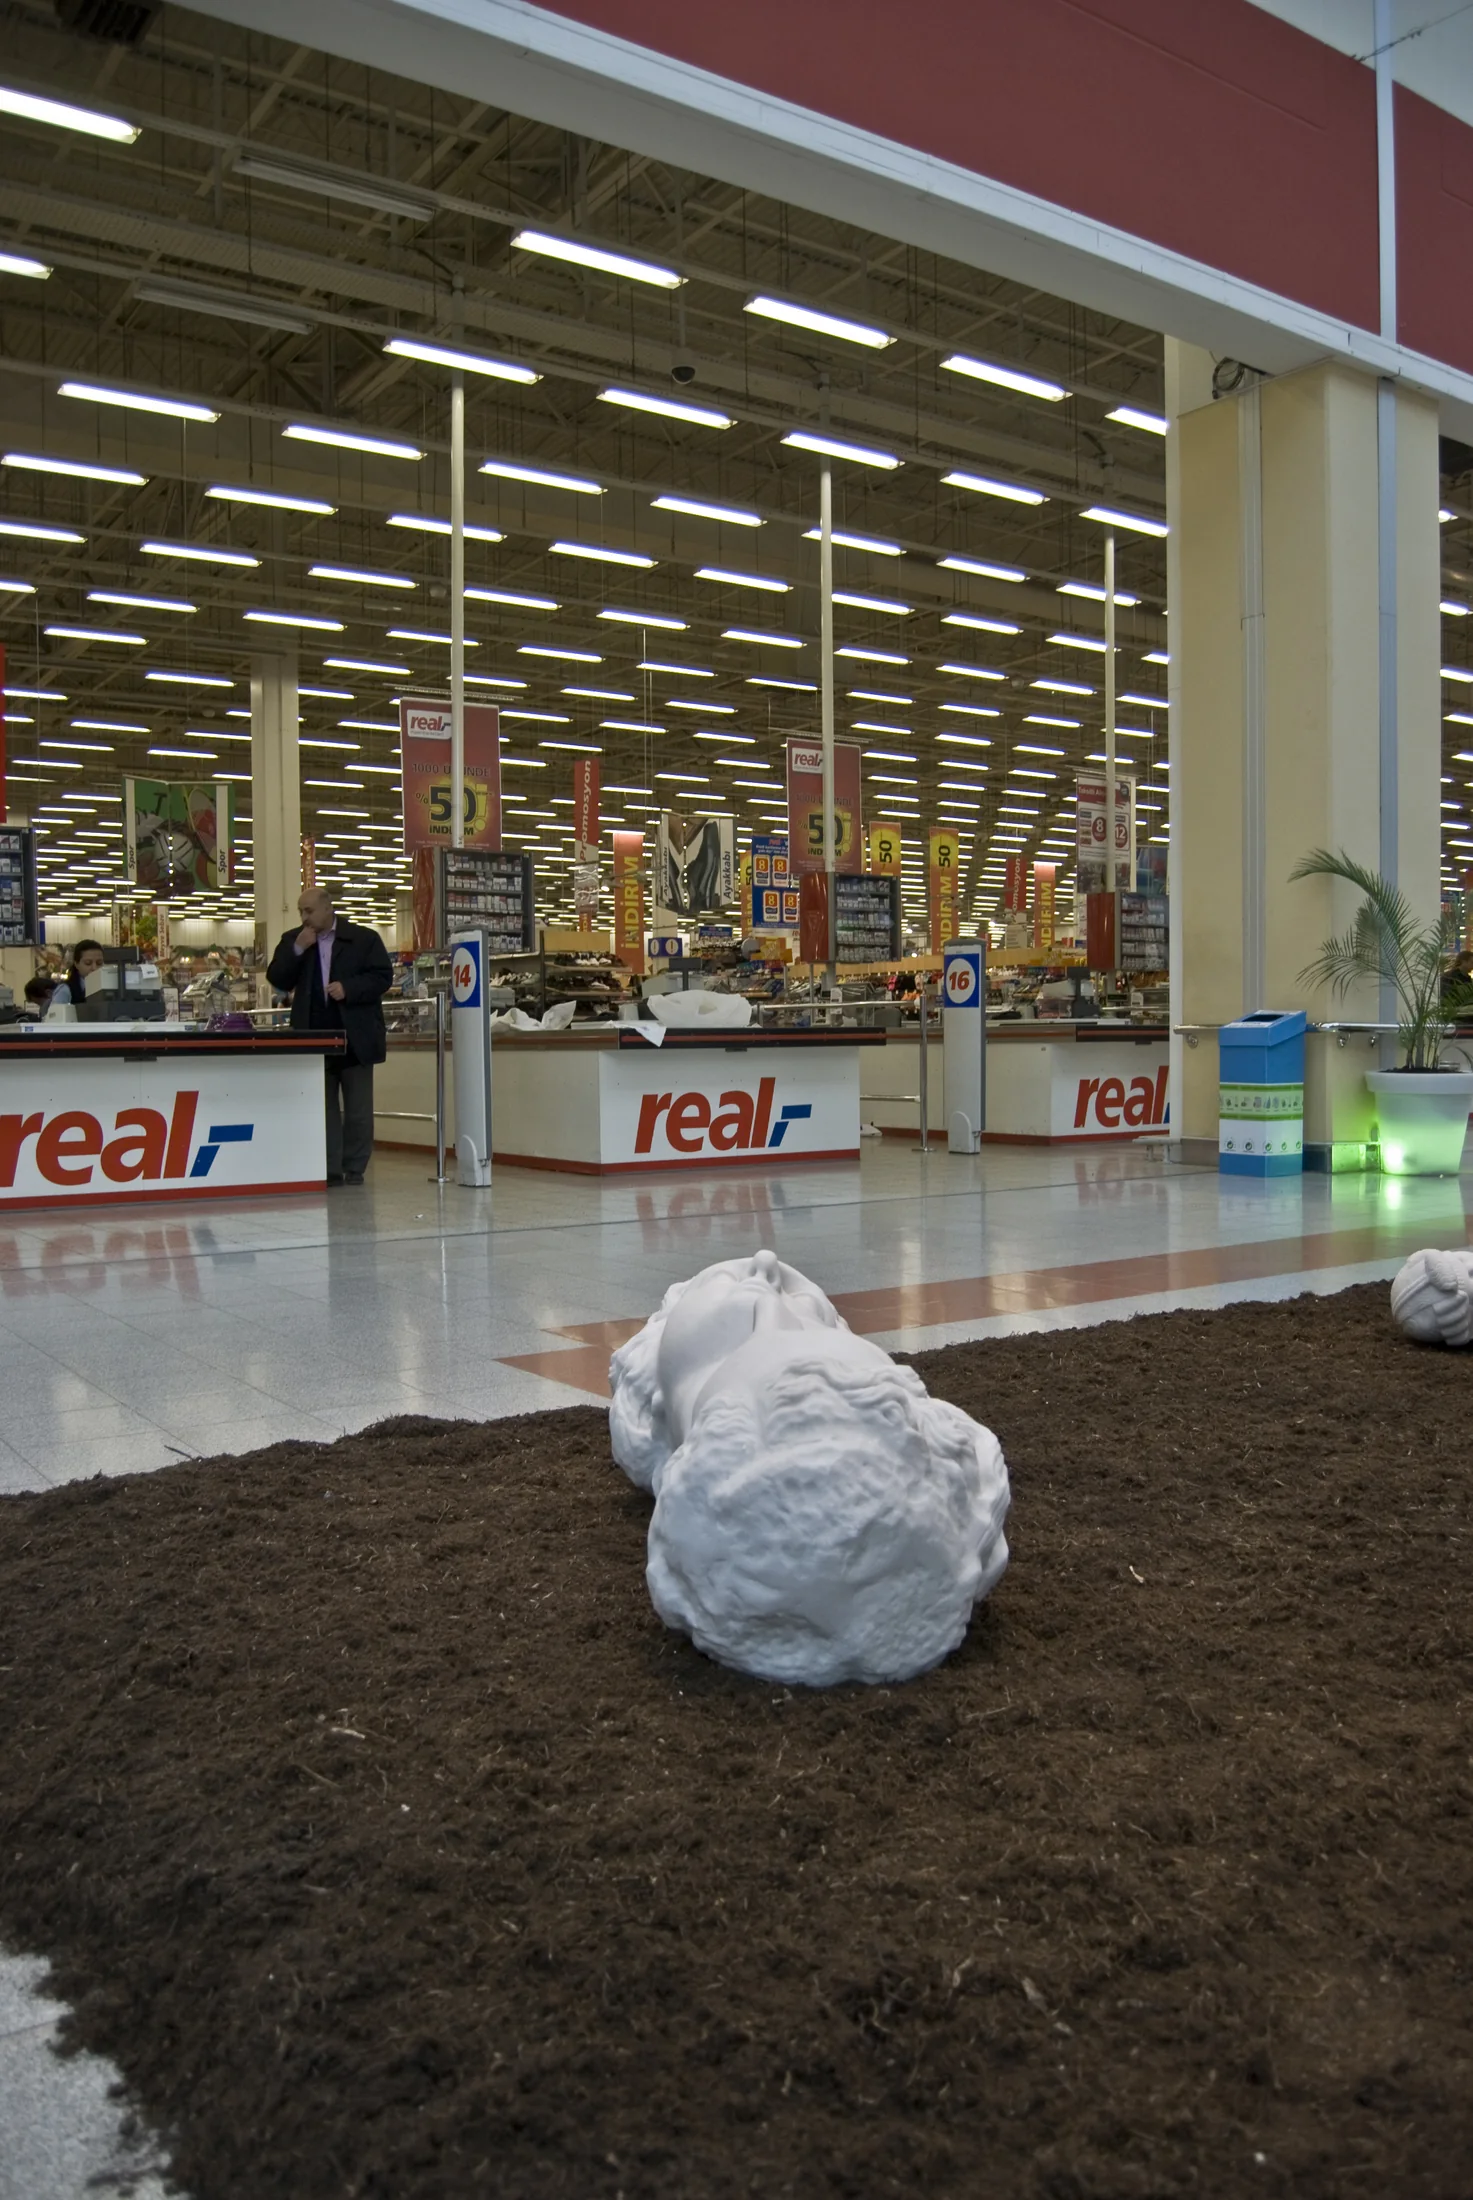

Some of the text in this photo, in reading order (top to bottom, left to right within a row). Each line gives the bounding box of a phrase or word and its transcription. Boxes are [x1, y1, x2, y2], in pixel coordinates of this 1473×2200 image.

[579, 760, 592, 861] Promosyon
[1096, 819, 1104, 833] 8
[1115, 826, 1126, 839] 12
[128, 845, 137, 870] Spor
[218, 849, 227, 874] Spor
[879, 840, 892, 864] 50
[938, 845, 951, 868] 50
[723, 851, 731, 899] Ayakkabı
[453, 964, 472, 988] 14
[949, 971, 970, 991] 16
